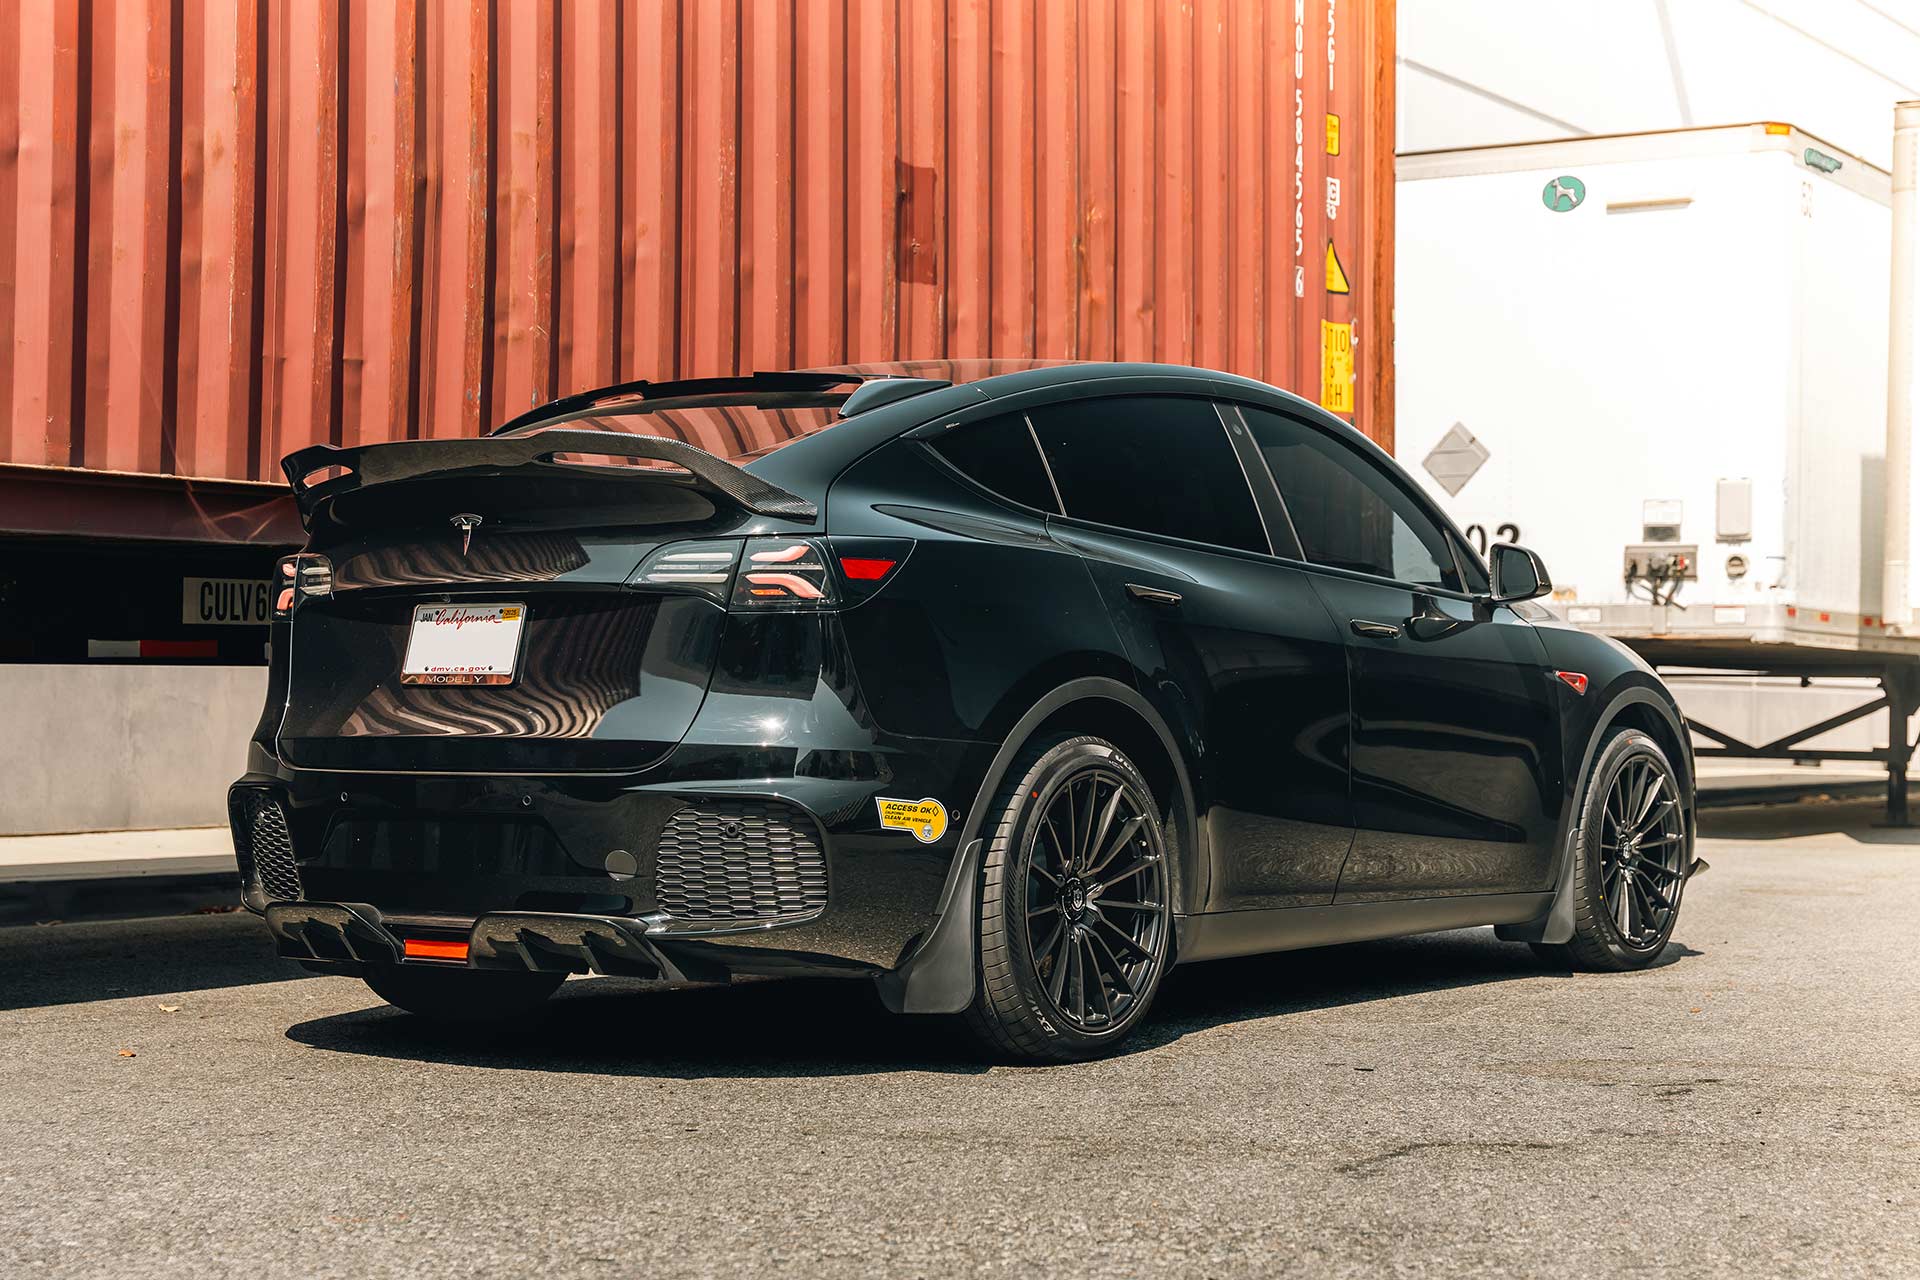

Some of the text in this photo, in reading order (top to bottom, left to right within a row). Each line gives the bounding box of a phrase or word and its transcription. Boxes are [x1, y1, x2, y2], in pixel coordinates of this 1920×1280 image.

[1295, 88, 1304, 257] 584565
[1295, 266, 1304, 297] 6
[255, 582, 272, 621] 6
[420, 613, 434, 622] JAN
[435, 608, 502, 630] California
[425, 675, 484, 683] MODEL Y
[885, 803, 932, 814] ACCESS OK
